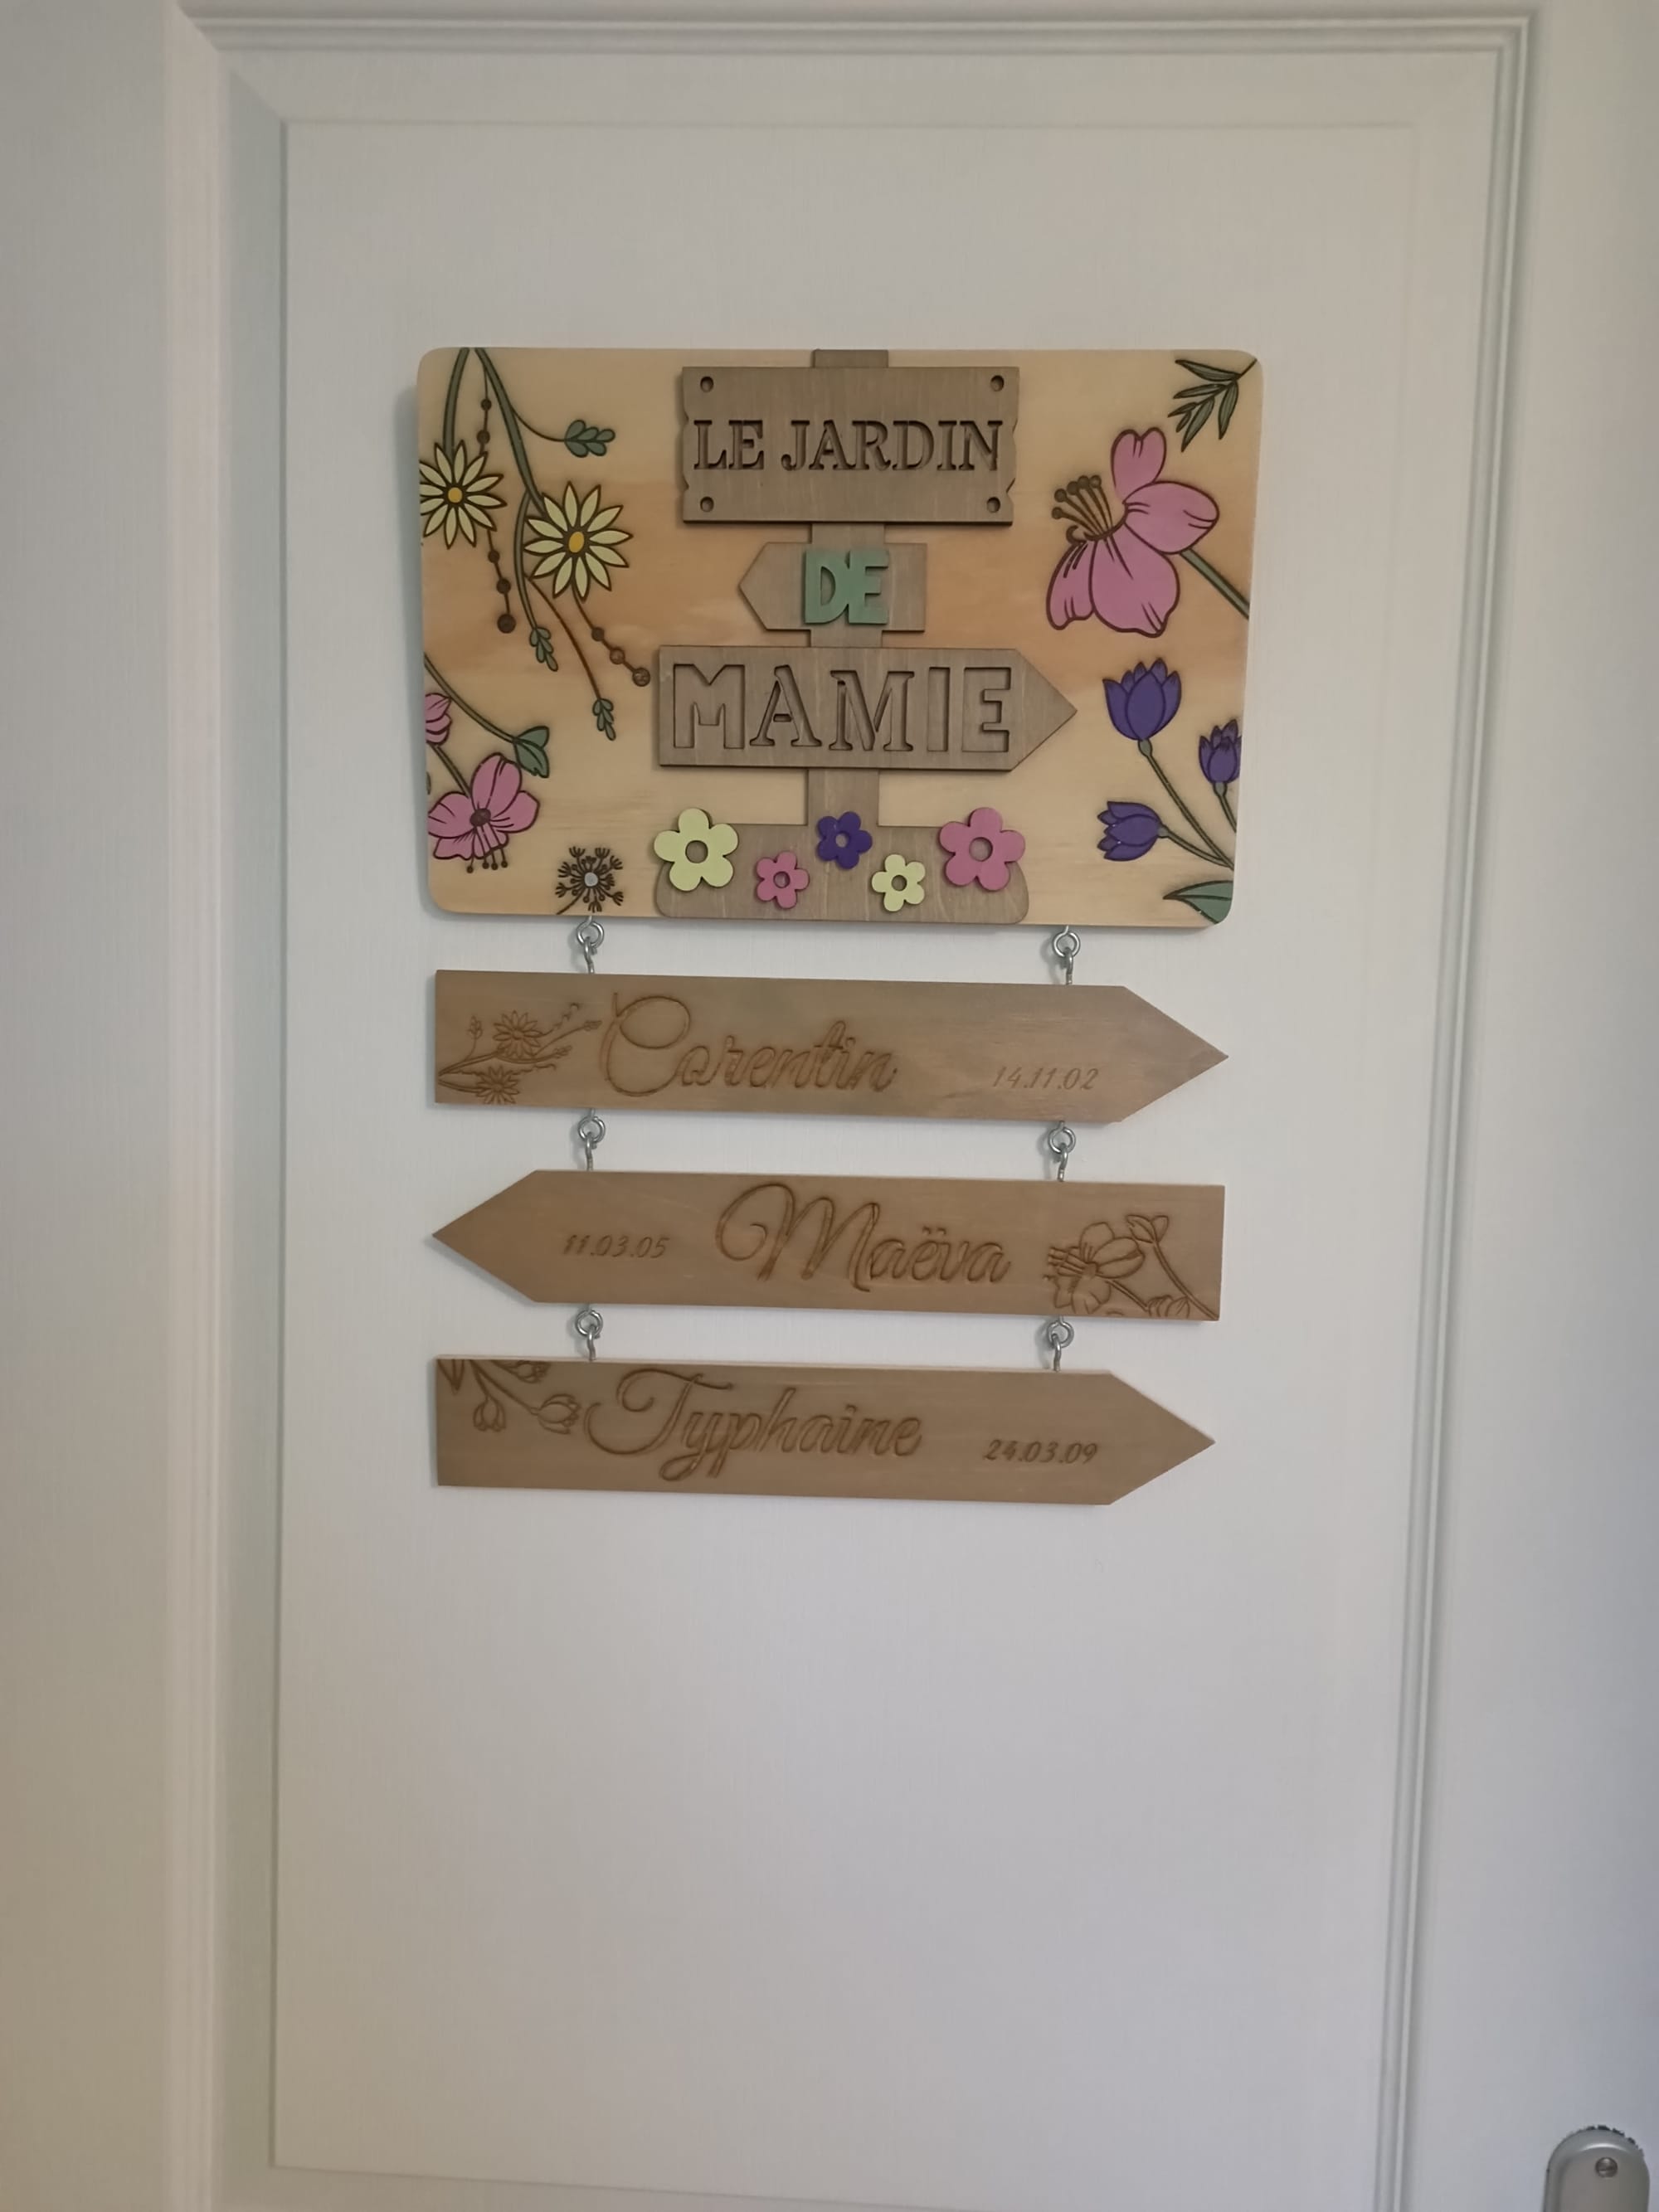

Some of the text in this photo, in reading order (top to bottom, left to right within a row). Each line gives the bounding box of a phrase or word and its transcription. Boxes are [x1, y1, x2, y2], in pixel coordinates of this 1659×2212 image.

[693, 419, 1004, 471] LE JARDIN
[802, 549, 889, 625] DE
[673, 664, 1012, 753] MAMIE
[599, 992, 1100, 1096] Corentin 14.11.02
[562, 1182, 1012, 1292] 11.03.05 Maëva
[583, 1368, 1098, 1482] Typhaine 24.03.09
